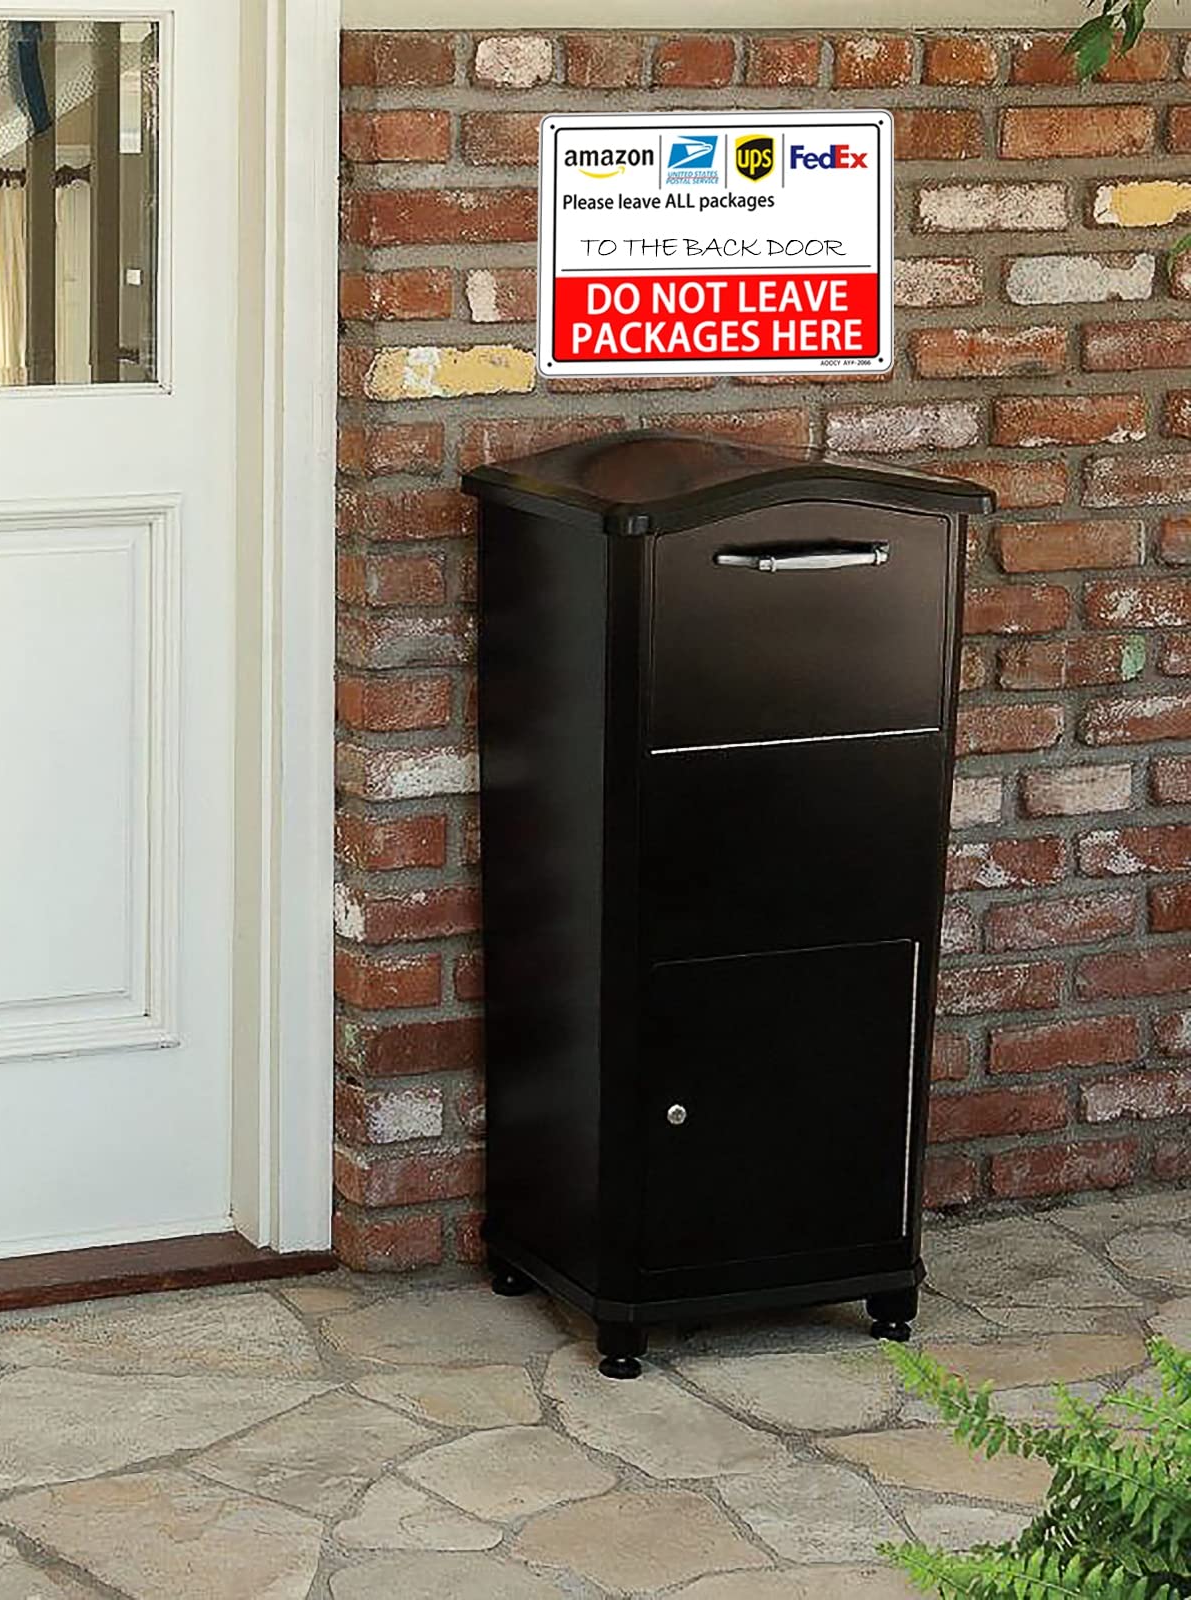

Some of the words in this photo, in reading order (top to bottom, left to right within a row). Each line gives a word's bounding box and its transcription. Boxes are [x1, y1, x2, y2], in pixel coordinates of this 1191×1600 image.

[564, 148, 654, 167] amazon
[737, 147, 772, 175] ups
[790, 144, 868, 169] FedEx
[563, 194, 614, 210] Please
[619, 194, 660, 209] leave
[665, 194, 694, 208] ALL
[699, 192, 775, 211] packages
[581, 239, 617, 256] TO
[624, 239, 677, 256] THE
[683, 239, 761, 256] BACK
[767, 239, 847, 256] DOOR
[587, 283, 640, 315] DO
[652, 282, 727, 314] NOT
[739, 280, 848, 313] LEAVE
[572, 320, 760, 354] PACKAGES
[772, 319, 863, 351] HERE
